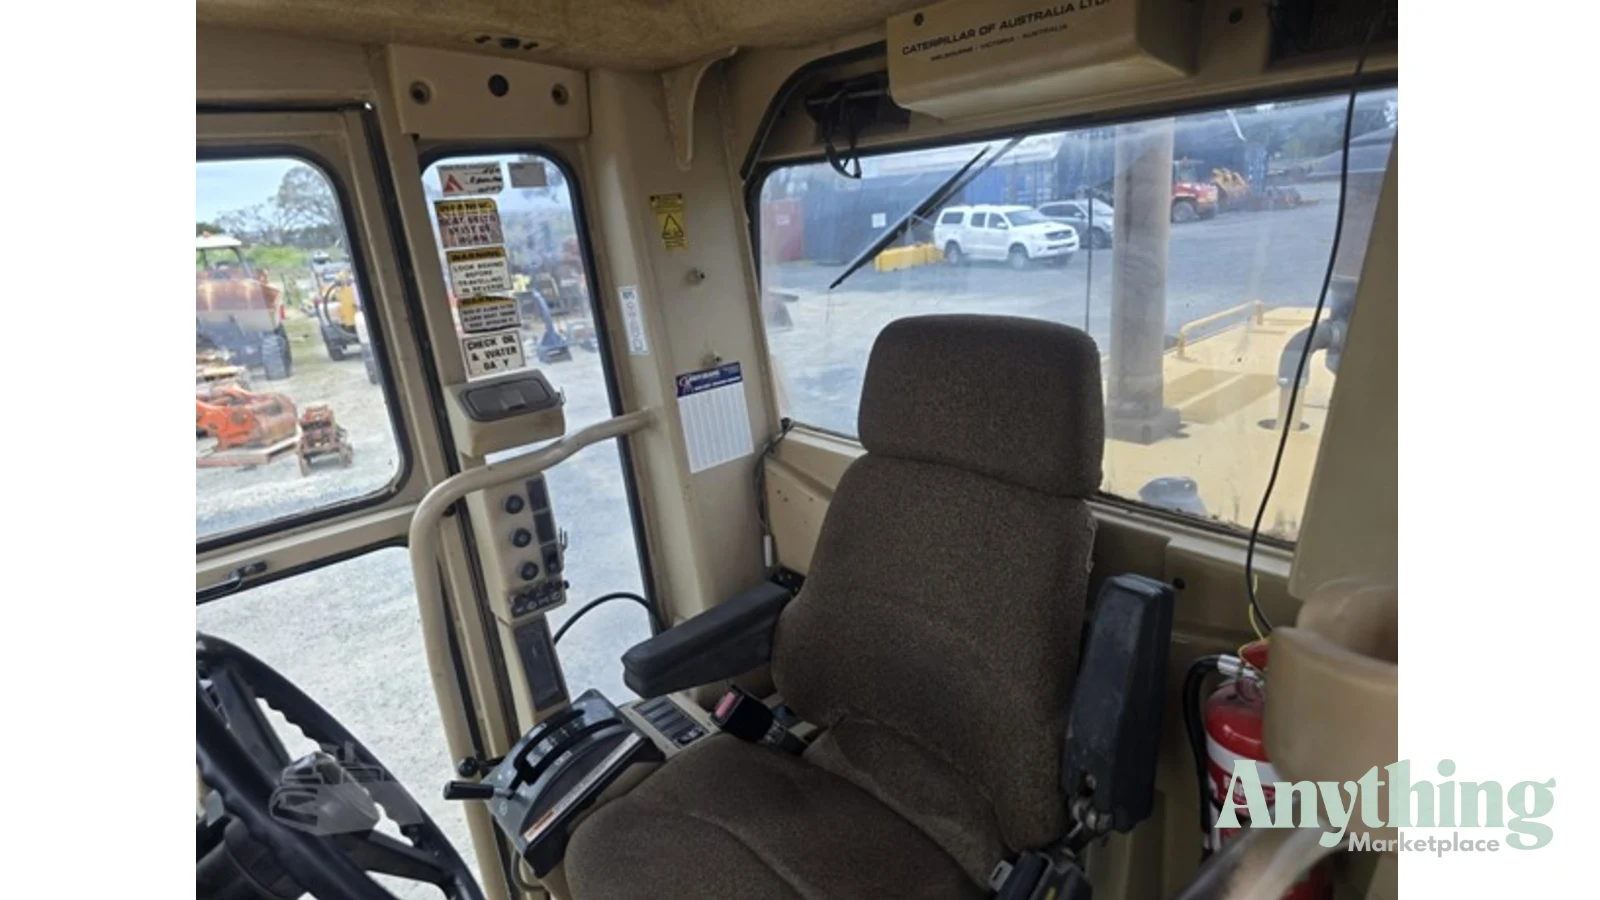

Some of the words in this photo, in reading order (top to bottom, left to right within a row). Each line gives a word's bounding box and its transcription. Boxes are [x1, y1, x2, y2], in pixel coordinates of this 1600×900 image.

[902, 28, 976, 56] CATERPILLAR
[978, 23, 996, 36] OF
[999, 3, 1075, 30] AUSTRALIA
[1022, 24, 1068, 39] AUSTRALIA
[467, 337, 497, 351] CHECK
[471, 352, 480, 361] &
[484, 345, 517, 359] WATER
